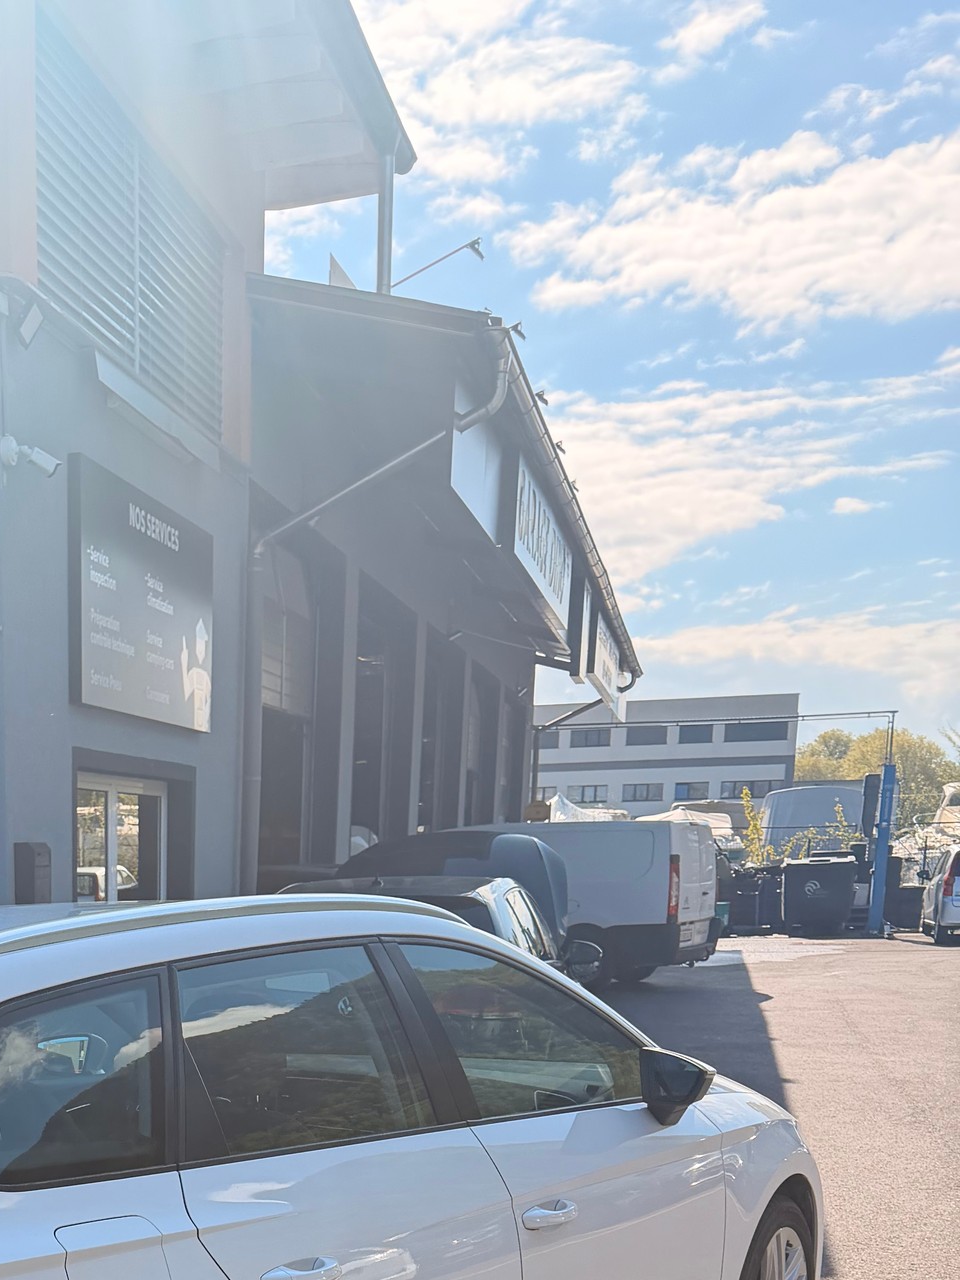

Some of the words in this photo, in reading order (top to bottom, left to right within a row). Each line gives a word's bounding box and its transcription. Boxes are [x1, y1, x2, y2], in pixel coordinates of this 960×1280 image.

[129, 503, 146, 534] NOS
[146, 513, 179, 552] SERVICES
[90, 566, 117, 592] inspection
